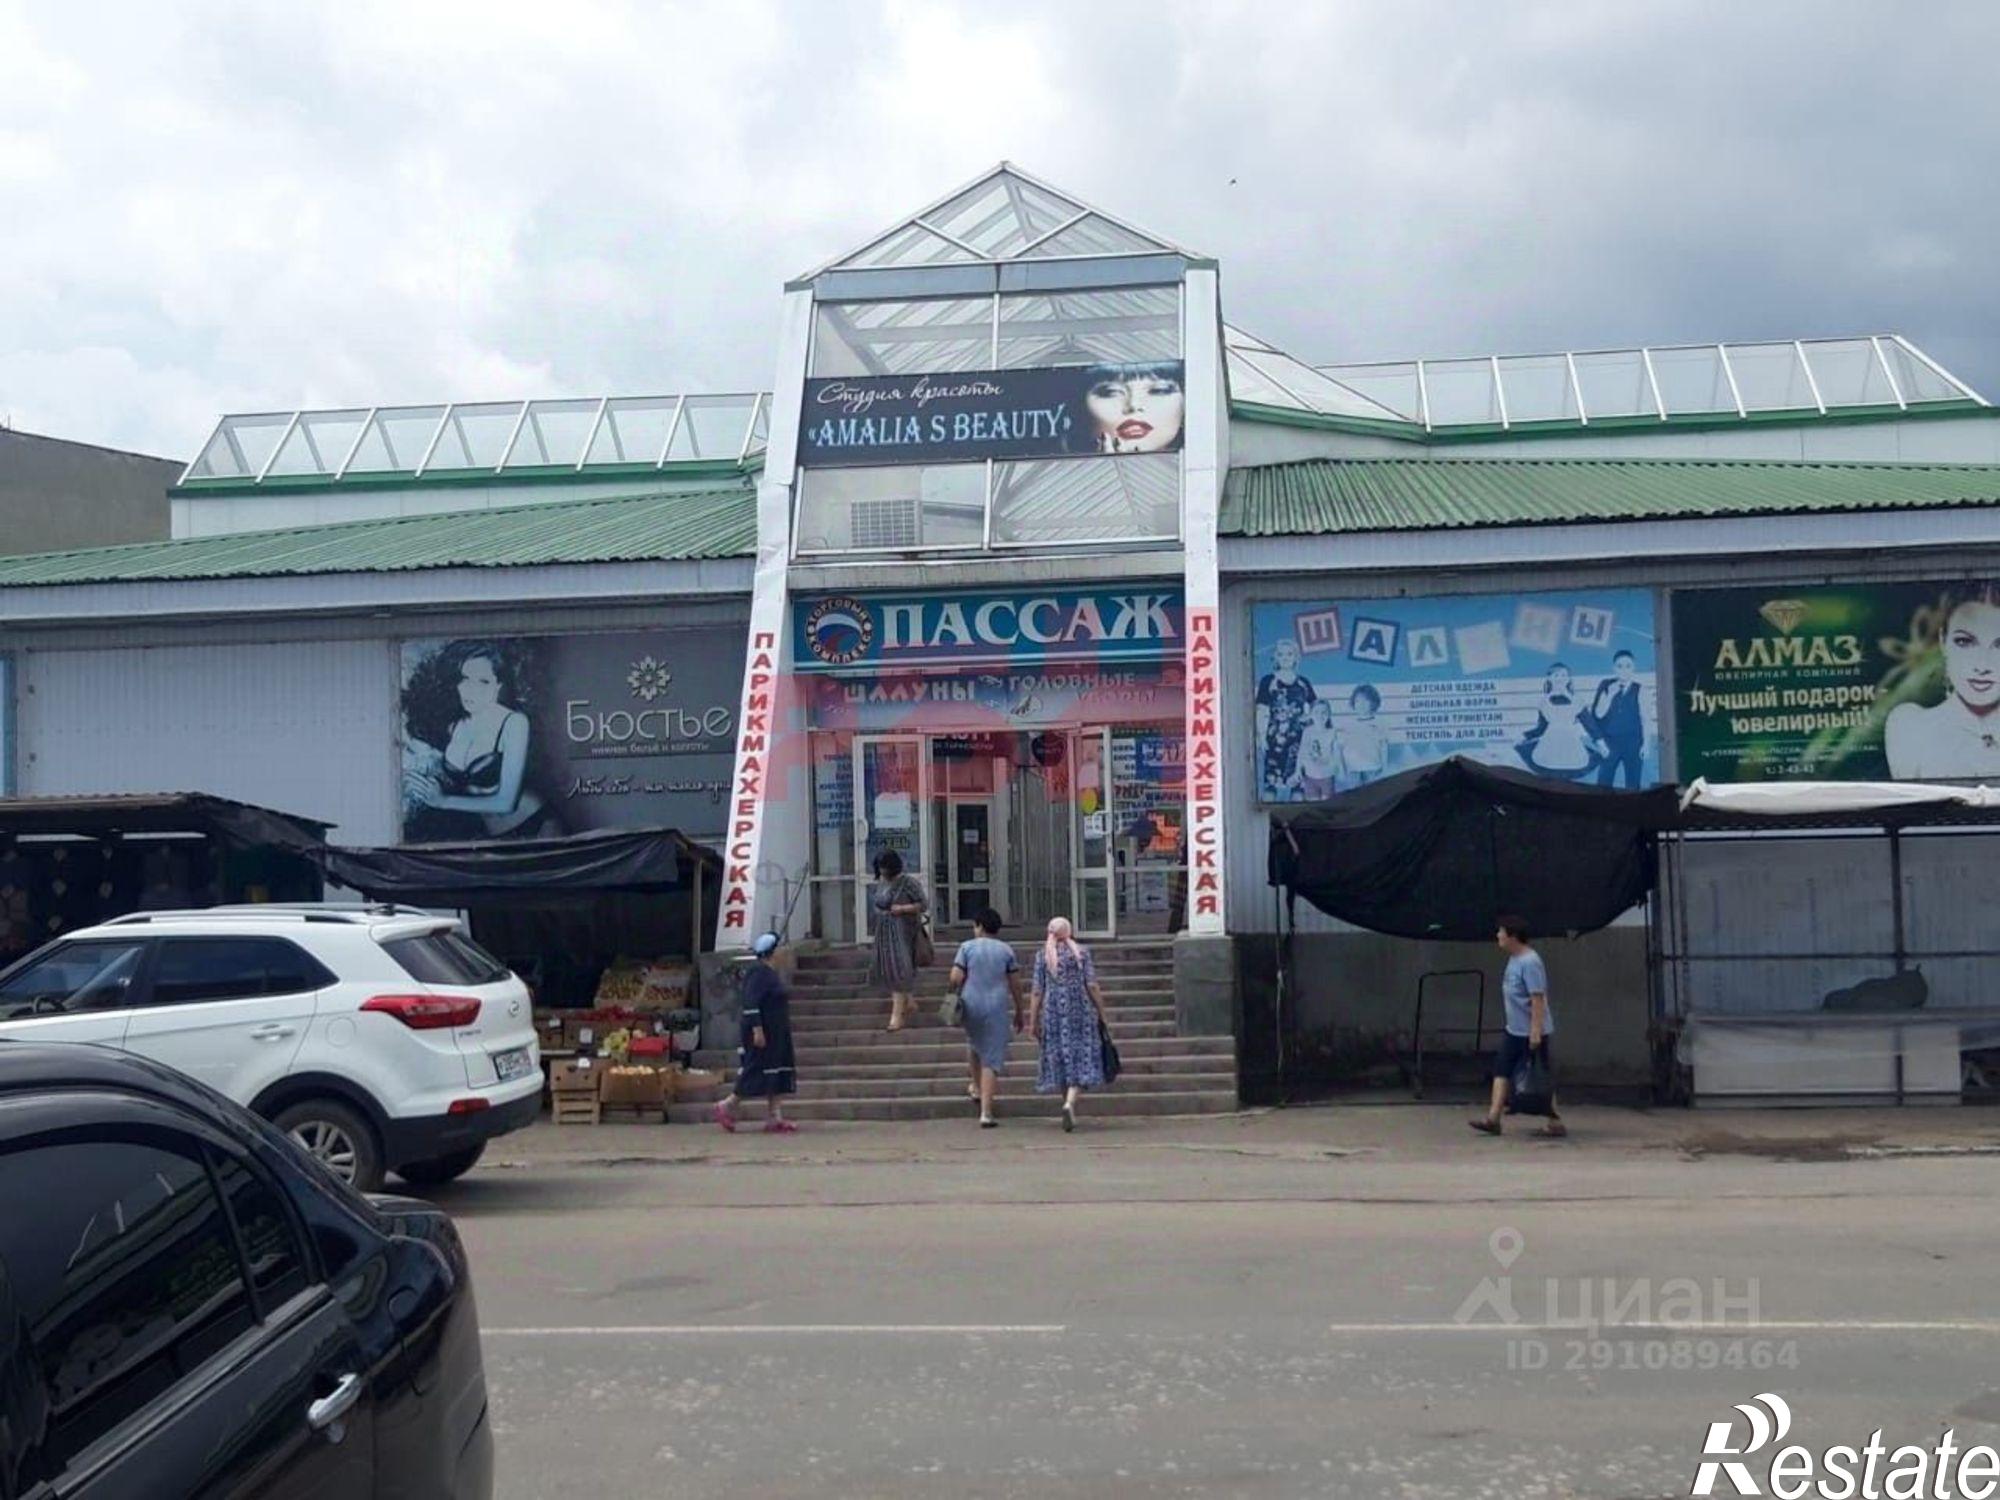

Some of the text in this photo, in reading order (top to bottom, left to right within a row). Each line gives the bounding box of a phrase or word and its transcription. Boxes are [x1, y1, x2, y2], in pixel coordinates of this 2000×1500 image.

[816, 374, 1004, 413] Студия красоты
[929, 414, 946, 443] S
[882, 594, 1178, 649] ПАССАЖ
[1714, 635, 1862, 669] АЛМАЗ
[1690, 686, 1777, 717] Лучший
[1783, 684, 1875, 709] подарок
[1731, 705, 1872, 735] ювелирный!
[566, 700, 732, 742] Бюстье
[724, 633, 774, 928] ПАРИКМАХЕРСКАЯ
[1189, 614, 1220, 915] ПАРИКМАХЕРСКАЯ
